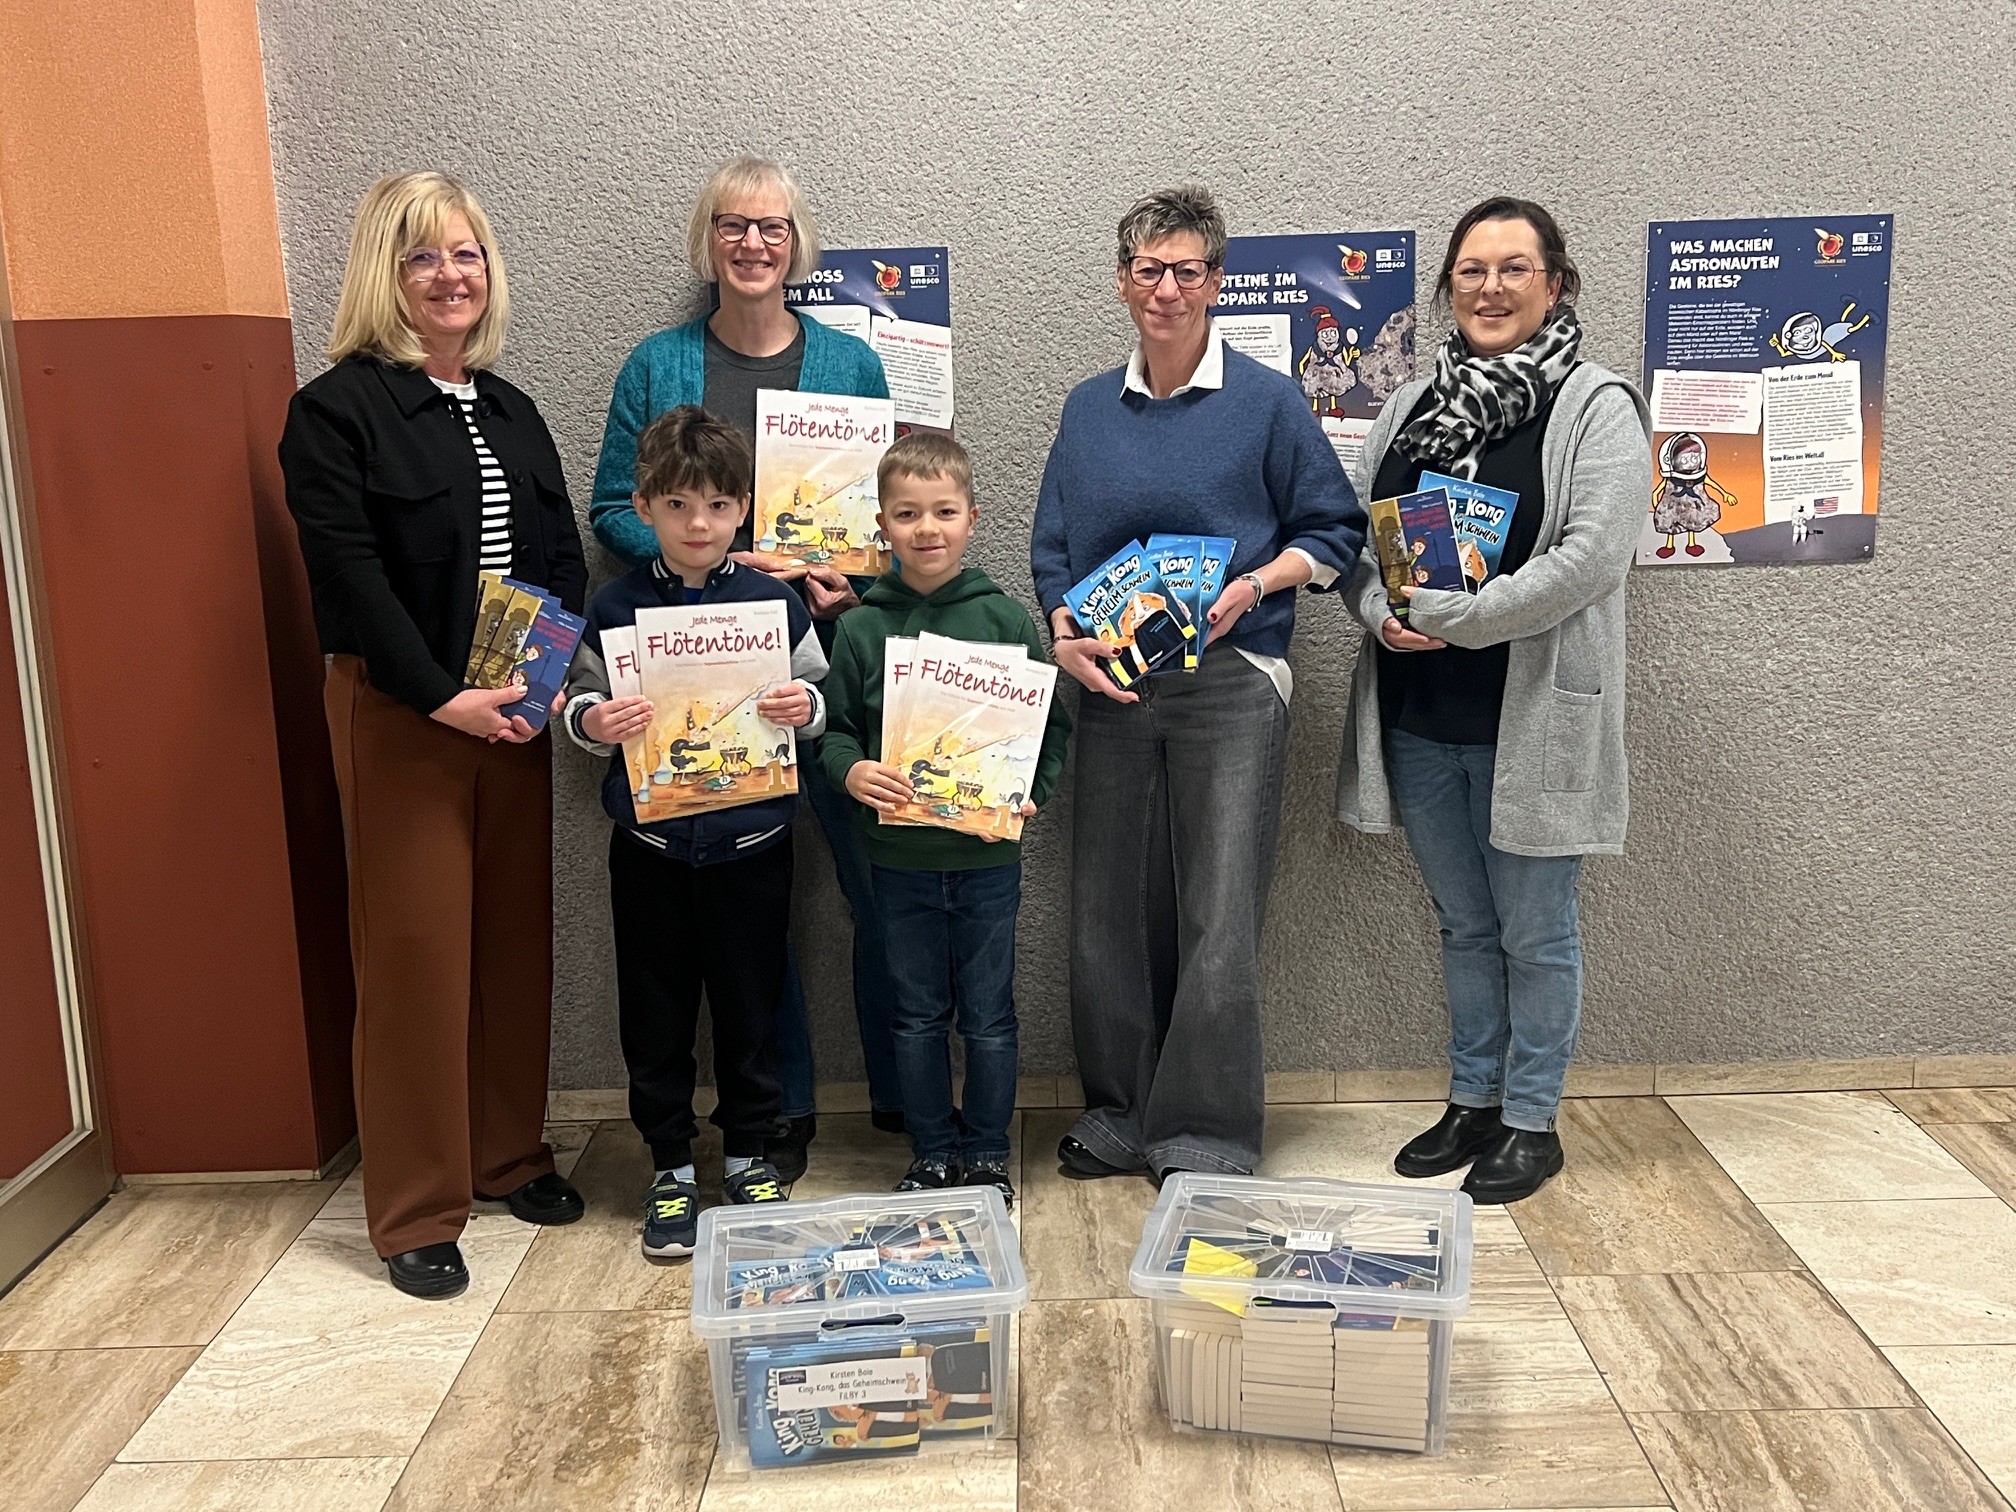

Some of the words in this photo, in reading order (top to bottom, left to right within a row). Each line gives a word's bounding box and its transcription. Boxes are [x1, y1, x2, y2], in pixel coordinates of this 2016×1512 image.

[1670, 240, 1705, 255] WAS
[1710, 238, 1774, 253] MACHEN
[1851, 245, 1883, 253] unesco
[1376, 261, 1406, 269] unesco
[1669, 256, 1780, 272] ASTRONAUTEN
[910, 277, 940, 285] unesco
[1274, 272, 1297, 286] IM
[1669, 276, 1692, 290] IM
[1697, 275, 1742, 289] RIES?
[807, 287, 835, 302] ALL
[1216, 291, 1268, 306] OPARK
[1273, 289, 1309, 304] RIES
[805, 403, 822, 414] Jede
[824, 404, 849, 416] Menge
[765, 413, 887, 443] Flötentöne!
[689, 614, 708, 628] Jede
[710, 615, 737, 628] Menge
[647, 627, 781, 659] Flötentöne!
[964, 655, 983, 666] Jede
[984, 658, 1010, 674] Menge
[920, 658, 1045, 708] Flötentöne!
[830, 1370, 856, 1379] Kirsten
[857, 1368, 874, 1377] Boie
[838, 1380, 851, 1389] das
[852, 1376, 907, 1389] Geheimschwein
[860, 1389, 867, 1398] 3
